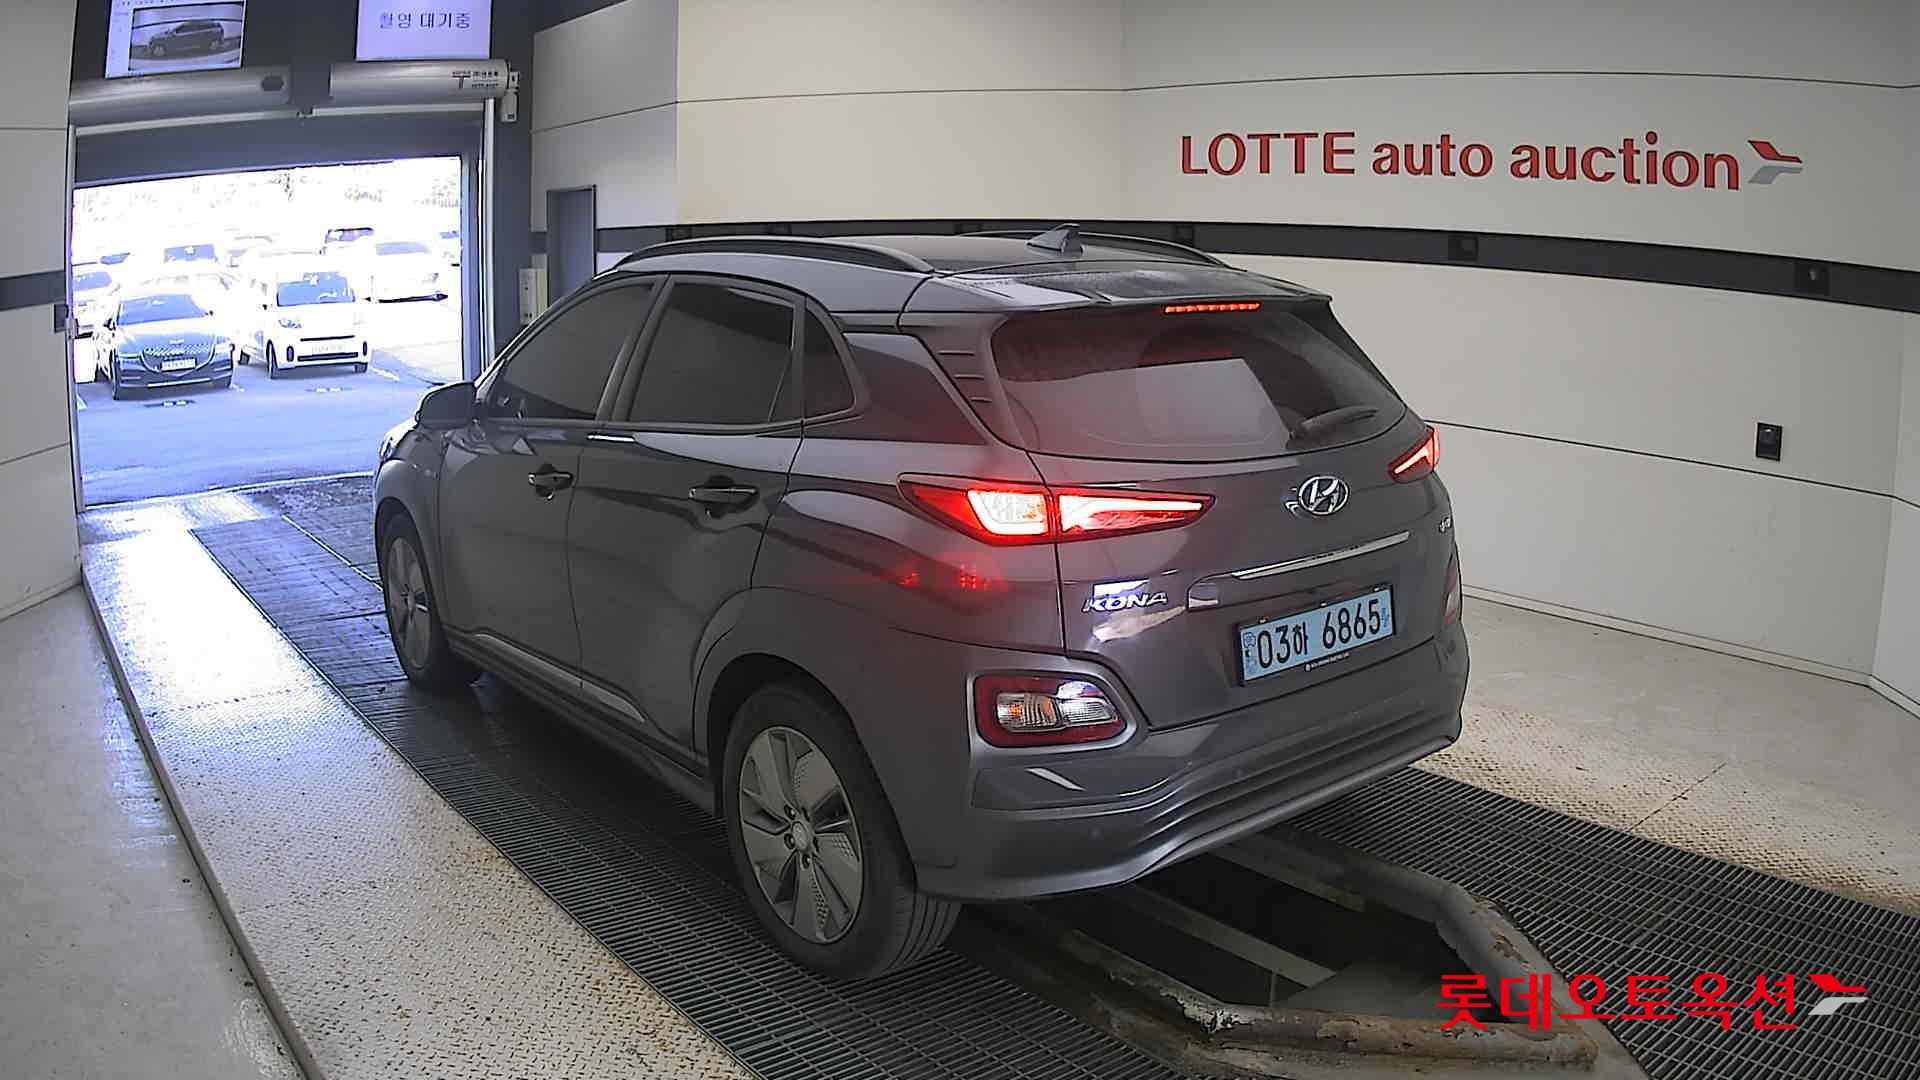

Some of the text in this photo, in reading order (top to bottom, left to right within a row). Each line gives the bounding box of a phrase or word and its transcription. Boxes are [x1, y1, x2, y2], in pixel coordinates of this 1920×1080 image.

[419, 11, 471, 29] 대기중
[1181, 131, 1741, 190] LOTTE auto auction
[1081, 592, 1168, 613] KONA
[1257, 621, 1308, 669] 03하
[1322, 598, 1381, 650] 6865
